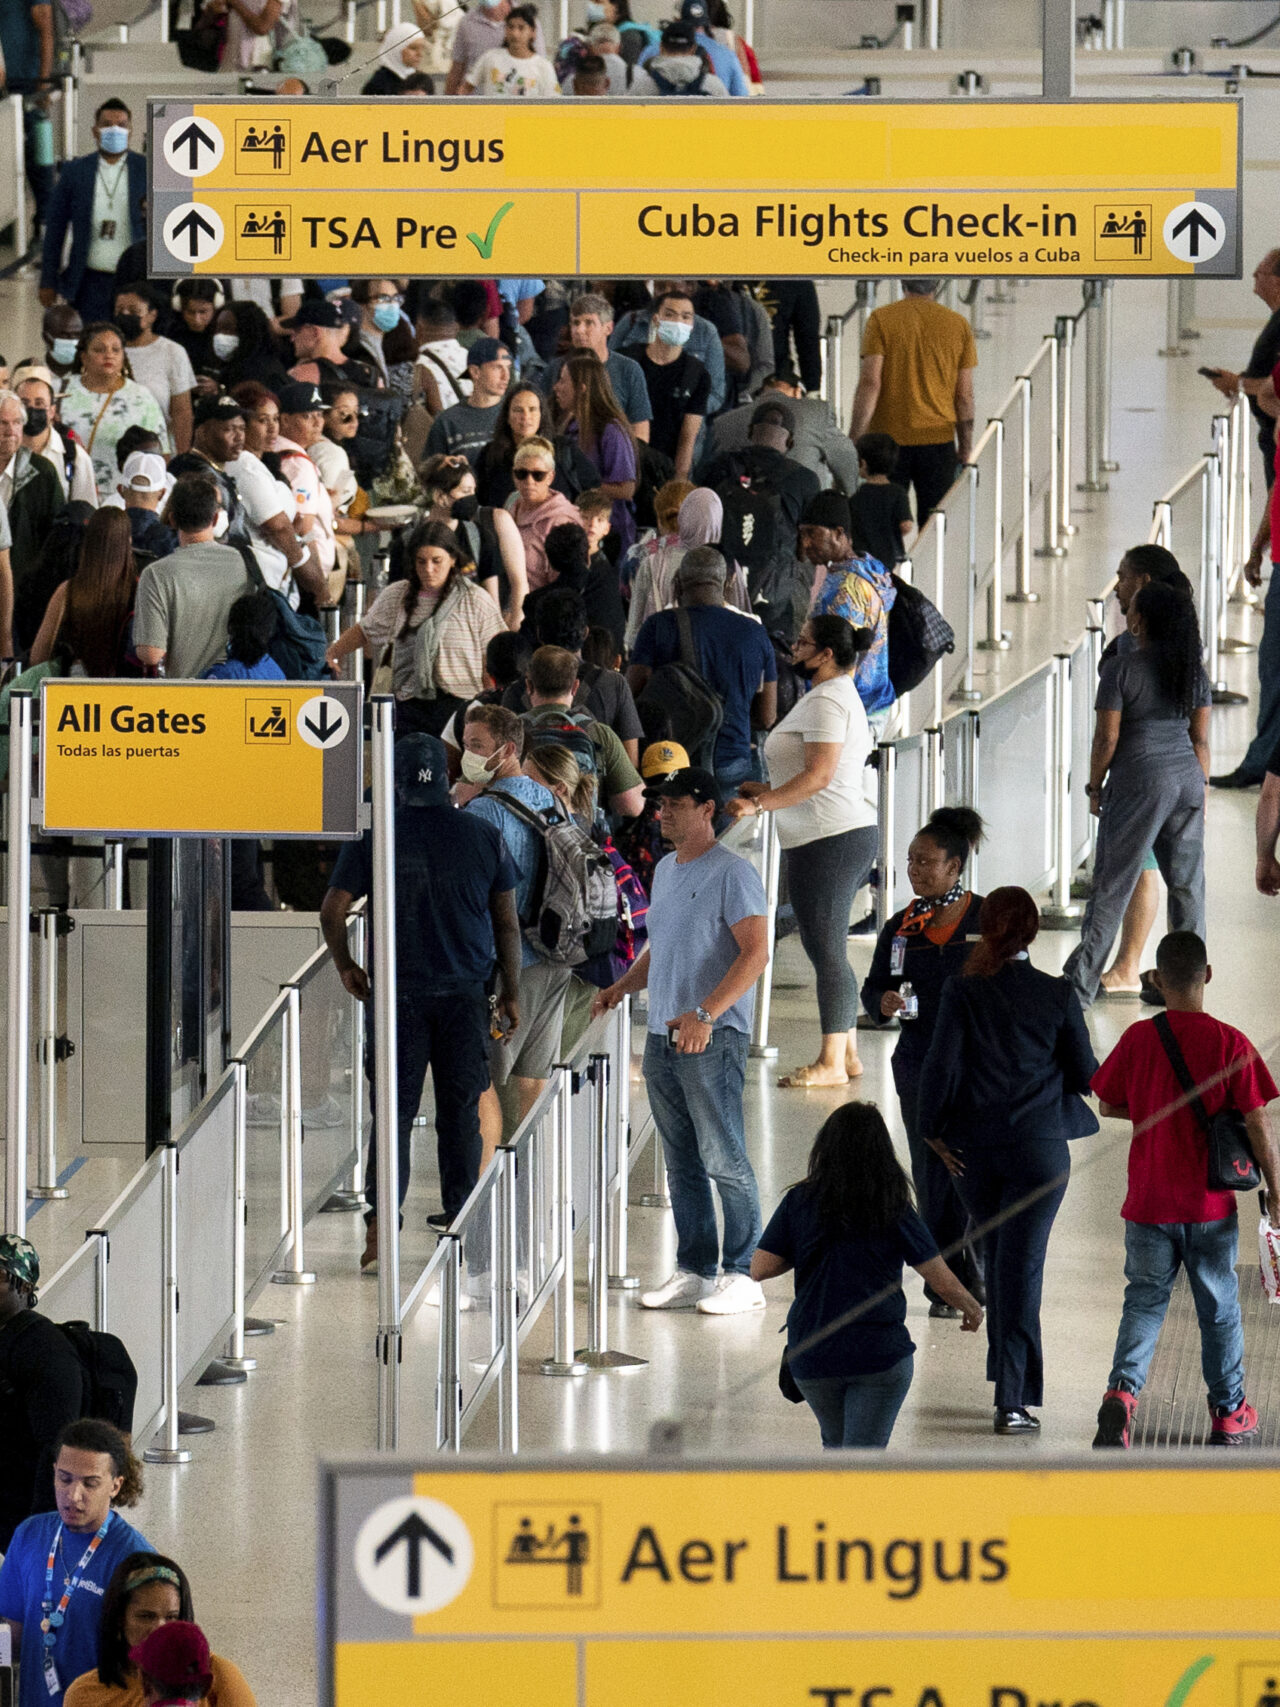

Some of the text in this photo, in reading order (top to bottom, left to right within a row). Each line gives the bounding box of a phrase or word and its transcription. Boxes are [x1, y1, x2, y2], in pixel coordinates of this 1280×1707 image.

[301, 129, 504, 172] Aer Lingus
[301, 216, 457, 249] TSA Pre
[637, 203, 1078, 247] Cuba Flights Check-in
[827, 247, 1081, 267] Check-in para vuelos a Cuba
[57, 704, 207, 734] All Gates
[57, 744, 180, 760] Todas las puertas
[620, 1521, 1011, 1600] Aer Lingus
[77, 1577, 105, 1597] jetBlue
